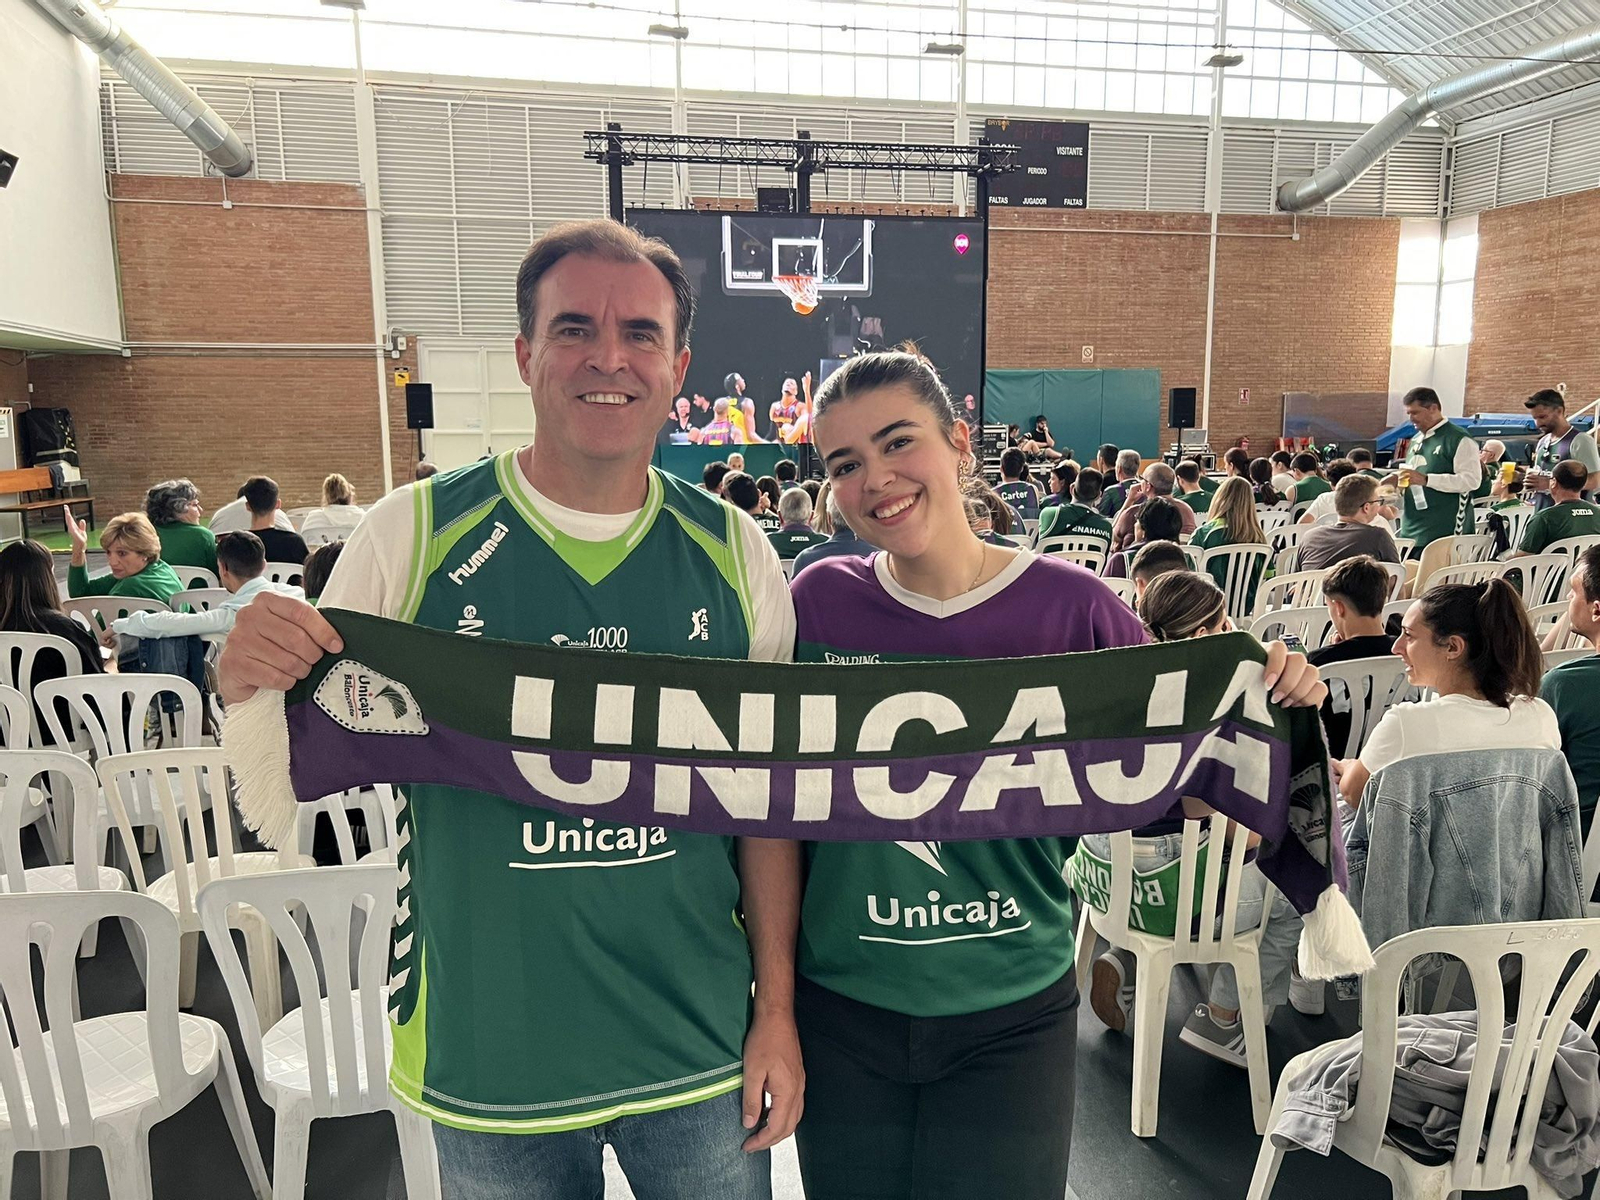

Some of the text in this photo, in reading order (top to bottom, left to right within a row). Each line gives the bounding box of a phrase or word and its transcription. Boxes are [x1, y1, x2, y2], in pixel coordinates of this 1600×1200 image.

[1056, 147, 1083, 156] VISITANTE
[1027, 167, 1048, 175] PERIODO
[988, 196, 1009, 205] FALTAS
[1022, 197, 1047, 205] JUGADOR
[1063, 198, 1083, 206] FALTAS
[1001, 491, 1028, 501] Carter
[448, 521, 509, 586] hummel
[567, 639, 589, 648] Unicaja
[357, 675, 375, 719] Unicaja
[509, 659, 1275, 822] UNICAJA
[522, 817, 668, 858] Unicaja
[867, 890, 1021, 929] Unicaja
